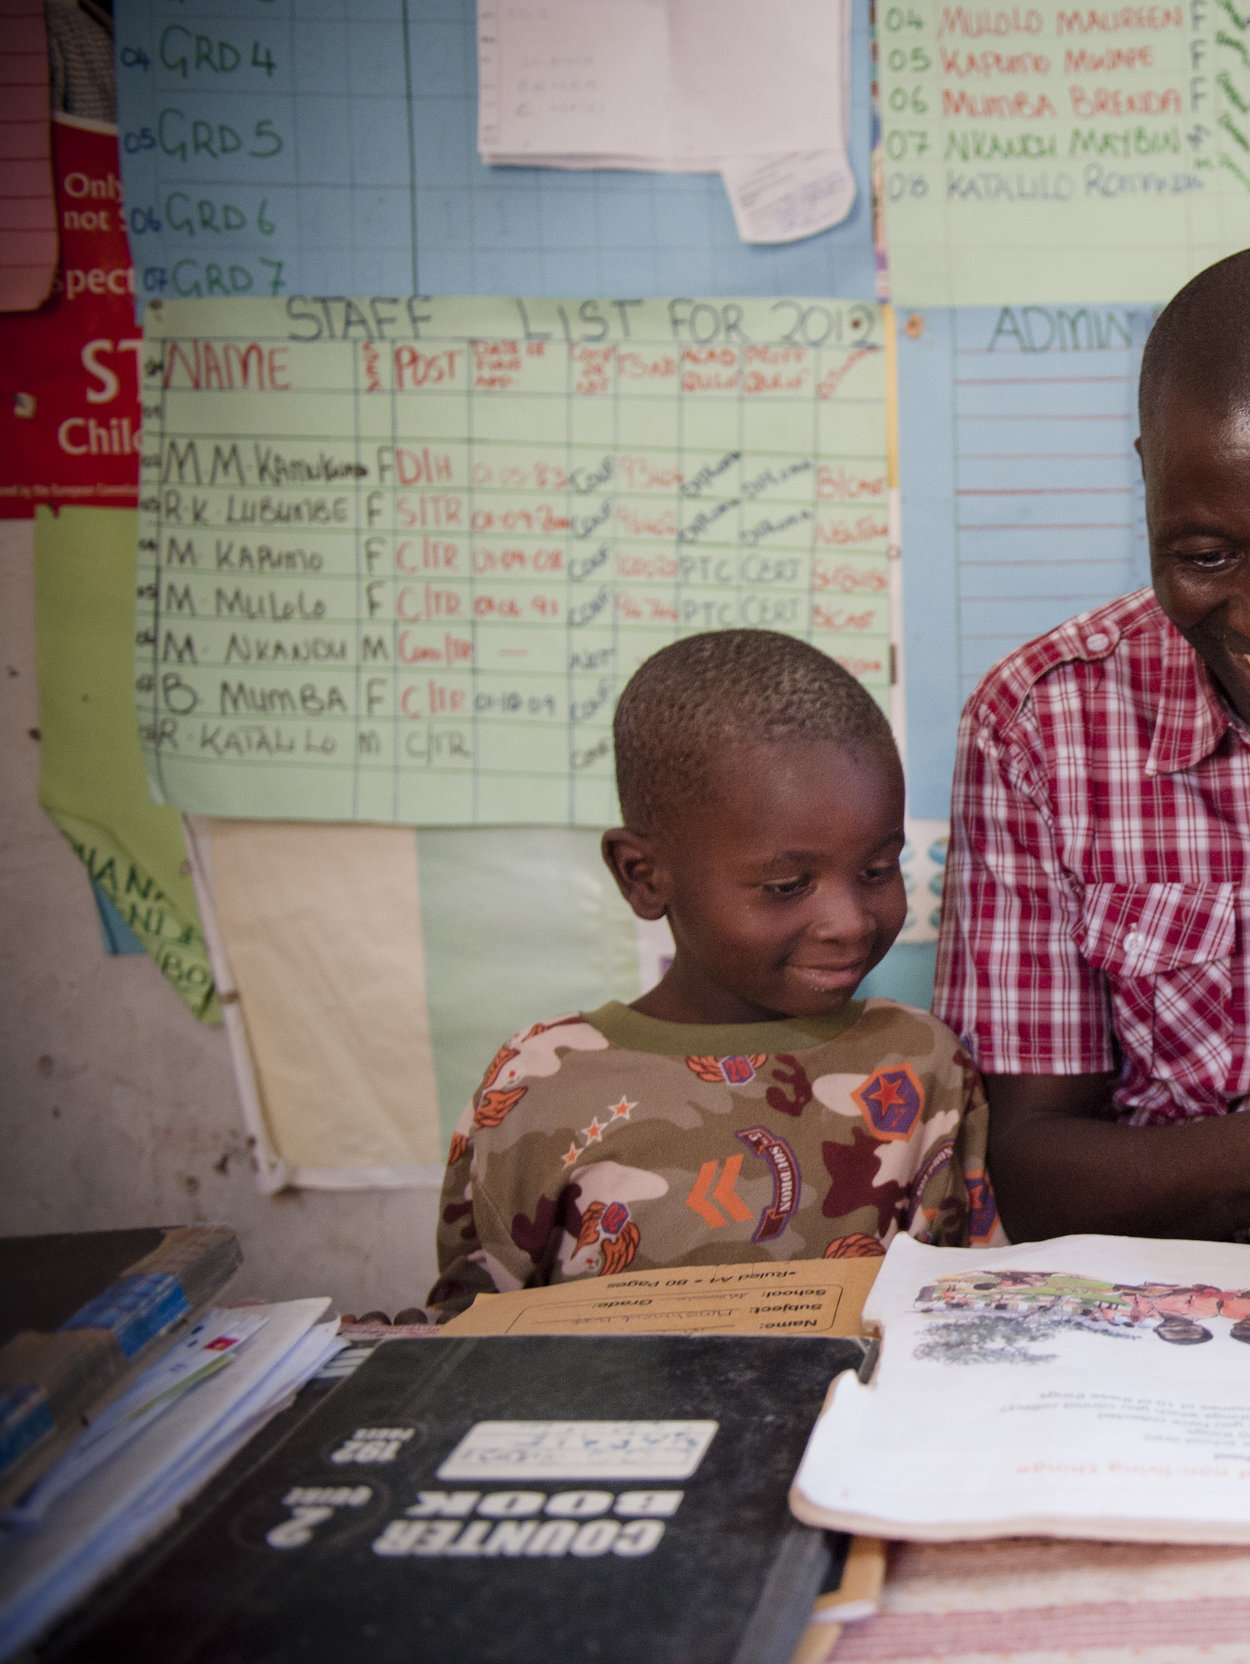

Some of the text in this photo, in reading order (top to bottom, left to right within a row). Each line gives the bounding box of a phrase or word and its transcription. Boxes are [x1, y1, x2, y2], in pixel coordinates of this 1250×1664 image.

[885, 7, 925, 33] 04
[160, 25, 241, 79] GRD
[251, 41, 276, 76] 4
[888, 48, 932, 73] 05
[888, 85, 929, 115] 06
[942, 87, 1058, 119] MUMBA
[1068, 84, 1183, 119] BRENDA
[158, 108, 242, 161] GRD
[248, 119, 283, 158] 5
[886, 129, 929, 160] 07
[64, 207, 110, 231] not
[165, 191, 247, 237] GRD
[257, 199, 277, 236] 6
[170, 257, 254, 298] GRD
[260, 256, 287, 297] 7
[287, 296, 878, 349] STAFF LIST FOR 2012
[163, 338, 291, 391] NAME
[395, 344, 463, 390] POST
[366, 490, 385, 527] F
[365, 536, 387, 574] F
[365, 580, 385, 619] F
[366, 677, 387, 716] F
[607, 1279, 660, 1290] Pages
[759, 1319, 818, 1331] Name:
[404, 1489, 686, 1518] BOOK
[266, 1507, 334, 1548] 2
[372, 1519, 666, 1558] COUNTER
